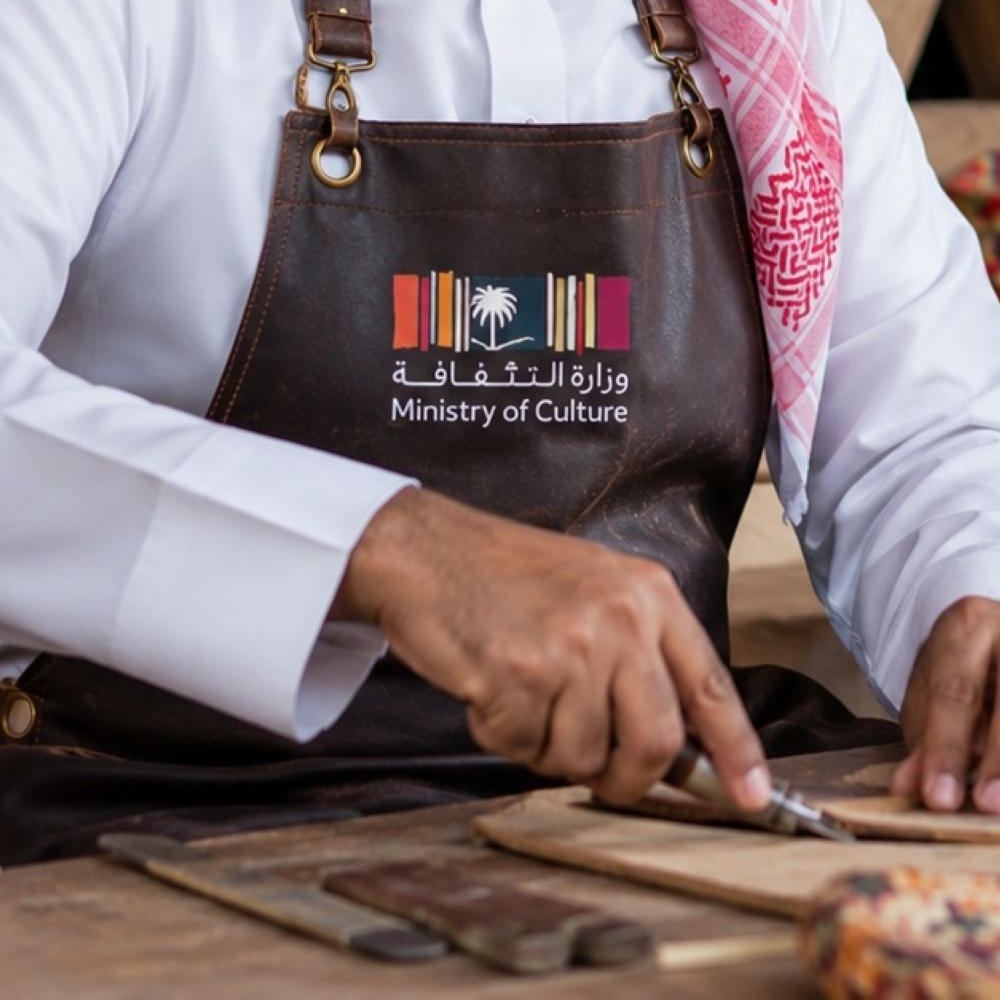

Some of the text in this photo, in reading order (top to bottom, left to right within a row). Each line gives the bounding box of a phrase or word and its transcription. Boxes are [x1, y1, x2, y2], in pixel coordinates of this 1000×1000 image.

[570, 361, 629, 395] وزارة
[391, 398, 628, 427] Ministry of Culture
